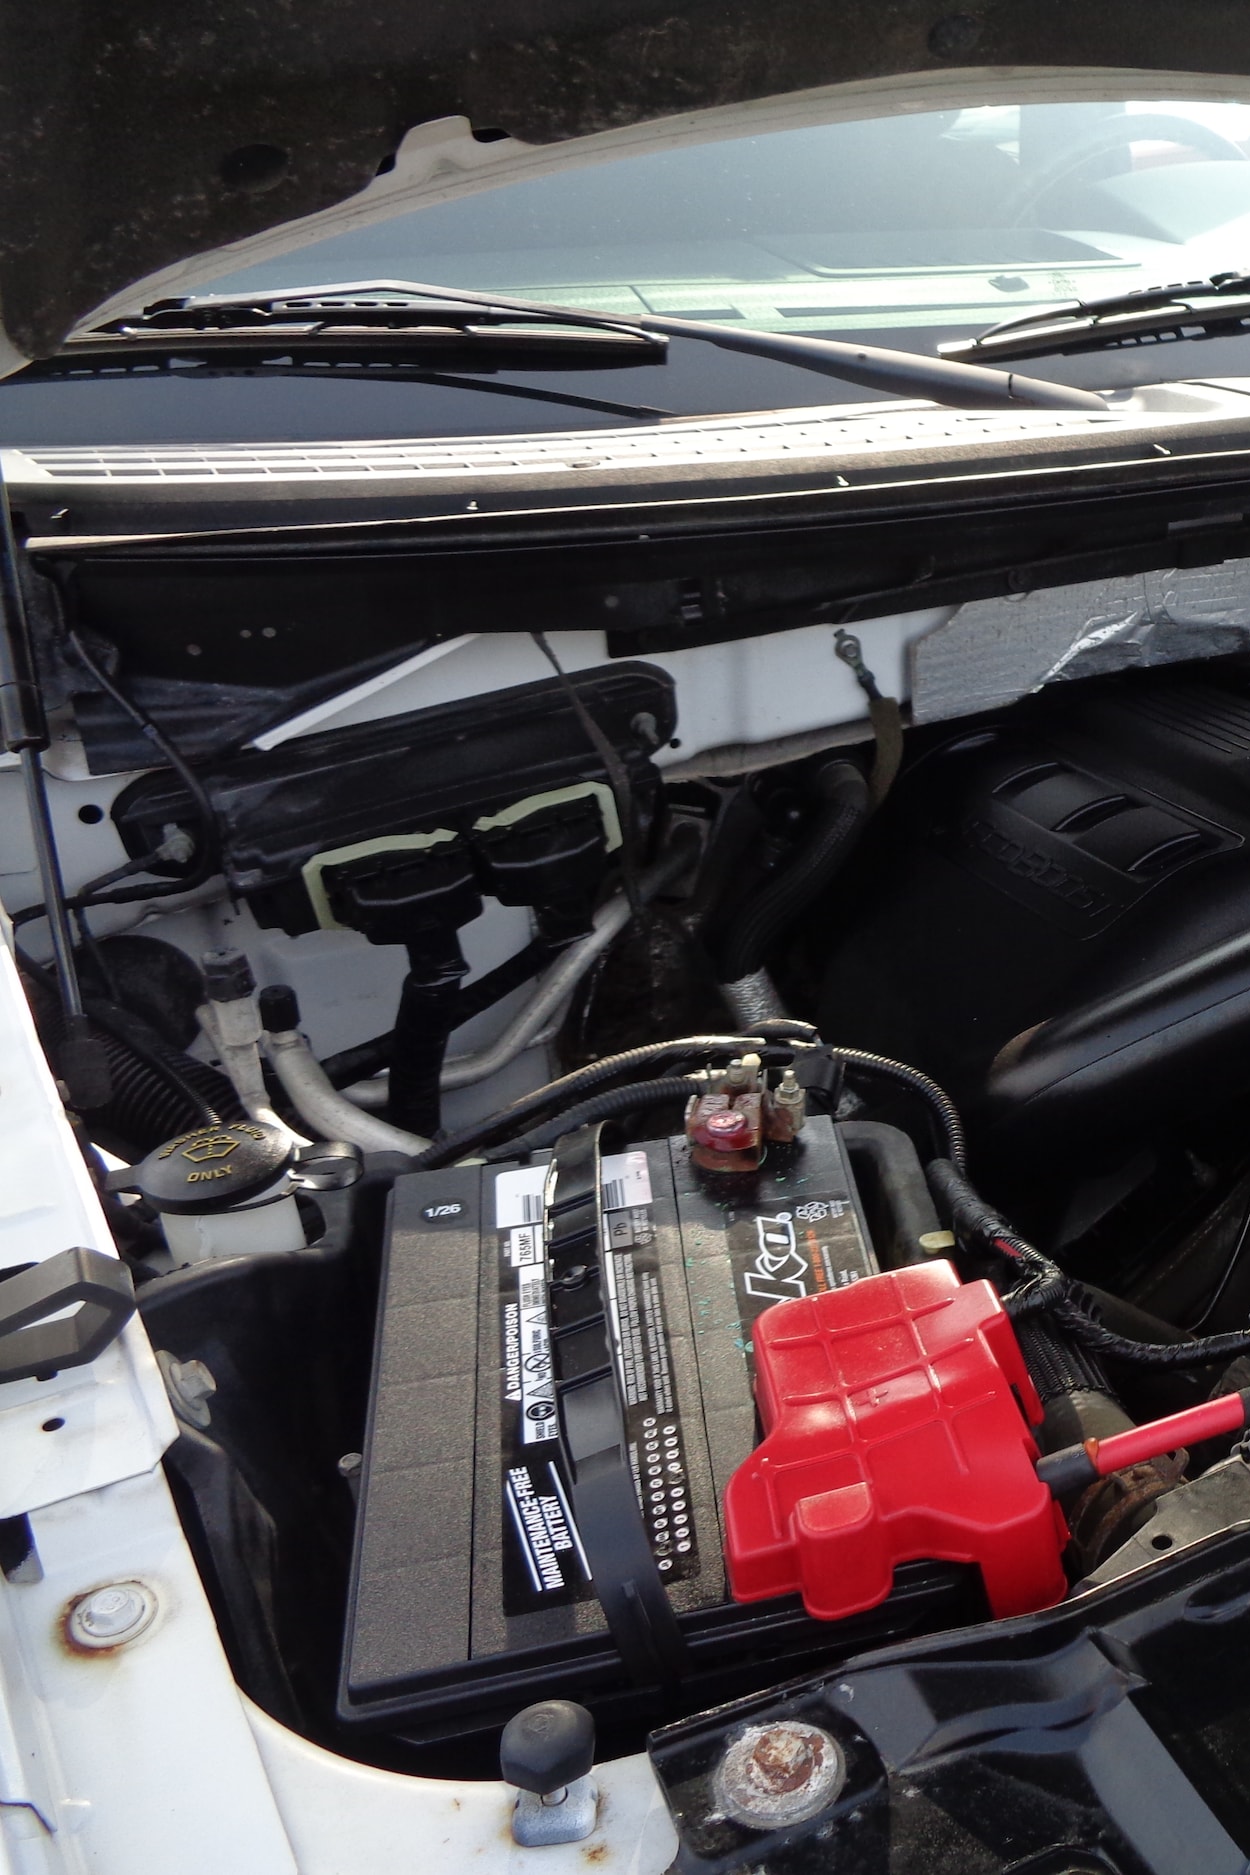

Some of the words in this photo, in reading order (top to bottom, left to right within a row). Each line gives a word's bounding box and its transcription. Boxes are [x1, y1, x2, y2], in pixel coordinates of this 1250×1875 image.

[158, 1126, 220, 1159] WASHER
[228, 1123, 266, 1140] FLUID
[187, 1164, 232, 1183] ONLY
[425, 1203, 461, 1217] 1/26
[613, 1222, 627, 1237] Pb
[519, 1233, 533, 1262] 765MF
[509, 1466, 565, 1590] MAINTENANCE-FREE
[538, 1494, 573, 1551] BATTERY
